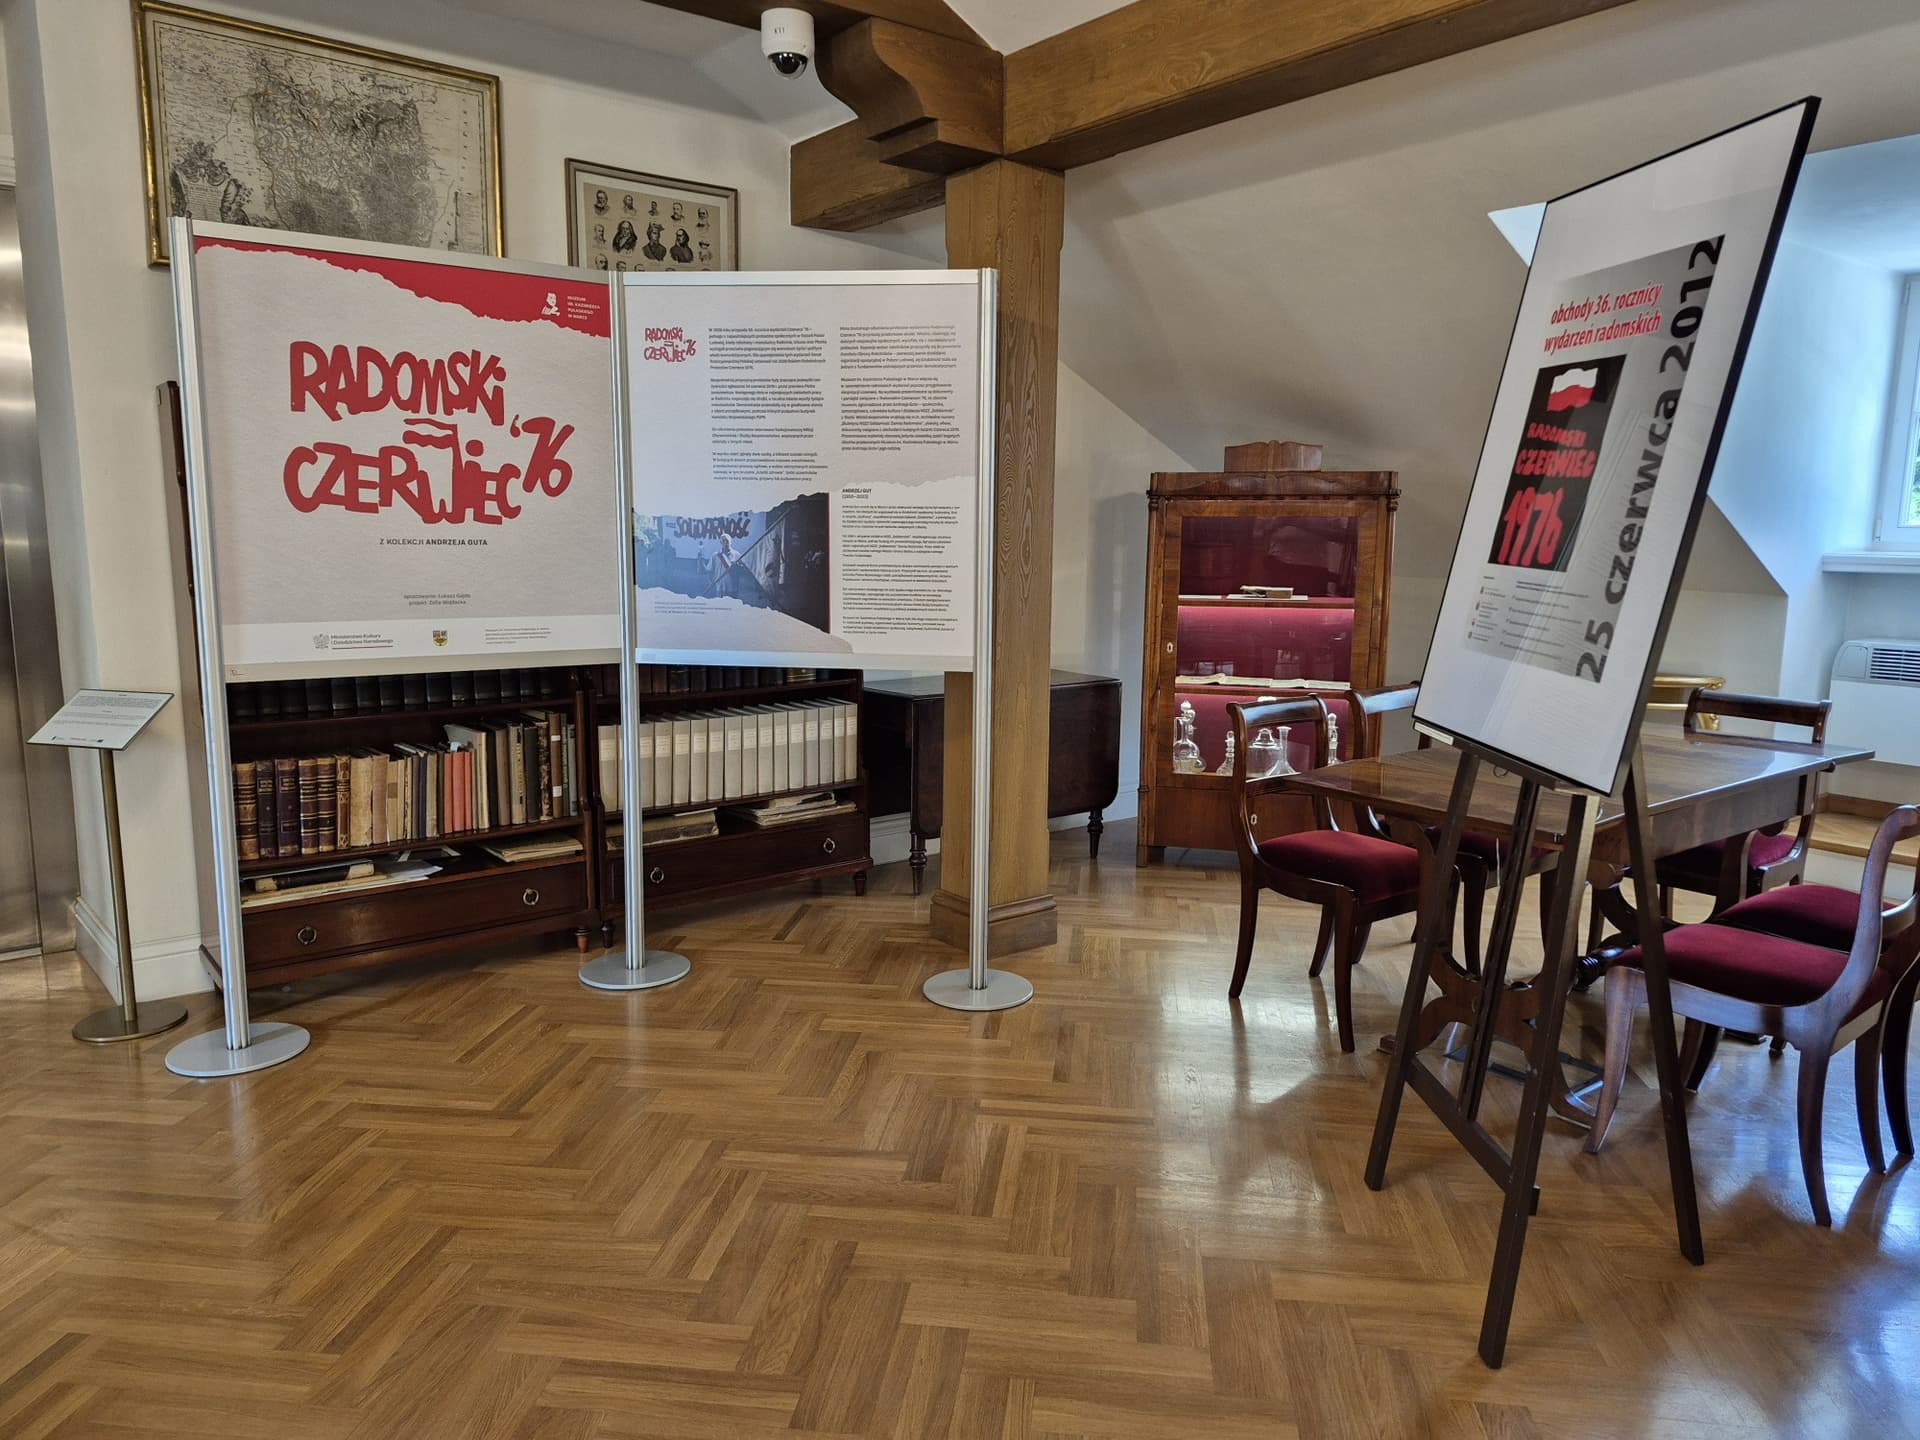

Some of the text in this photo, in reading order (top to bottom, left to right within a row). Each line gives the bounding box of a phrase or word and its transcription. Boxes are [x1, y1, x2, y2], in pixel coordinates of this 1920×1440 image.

[1551, 280, 1664, 325] obchody 36. rocznicy
[1544, 311, 1662, 355] wydarzeń radomskich
[1527, 422, 1587, 447] RADOMSKI
[1515, 449, 1599, 478] CZERWIEC
[1575, 235, 1724, 684] 25 czerwca 2012
[379, 538, 489, 546] Z KOLEKCJI ANDRZEJA GUTA
[1496, 486, 1565, 567] 1976
